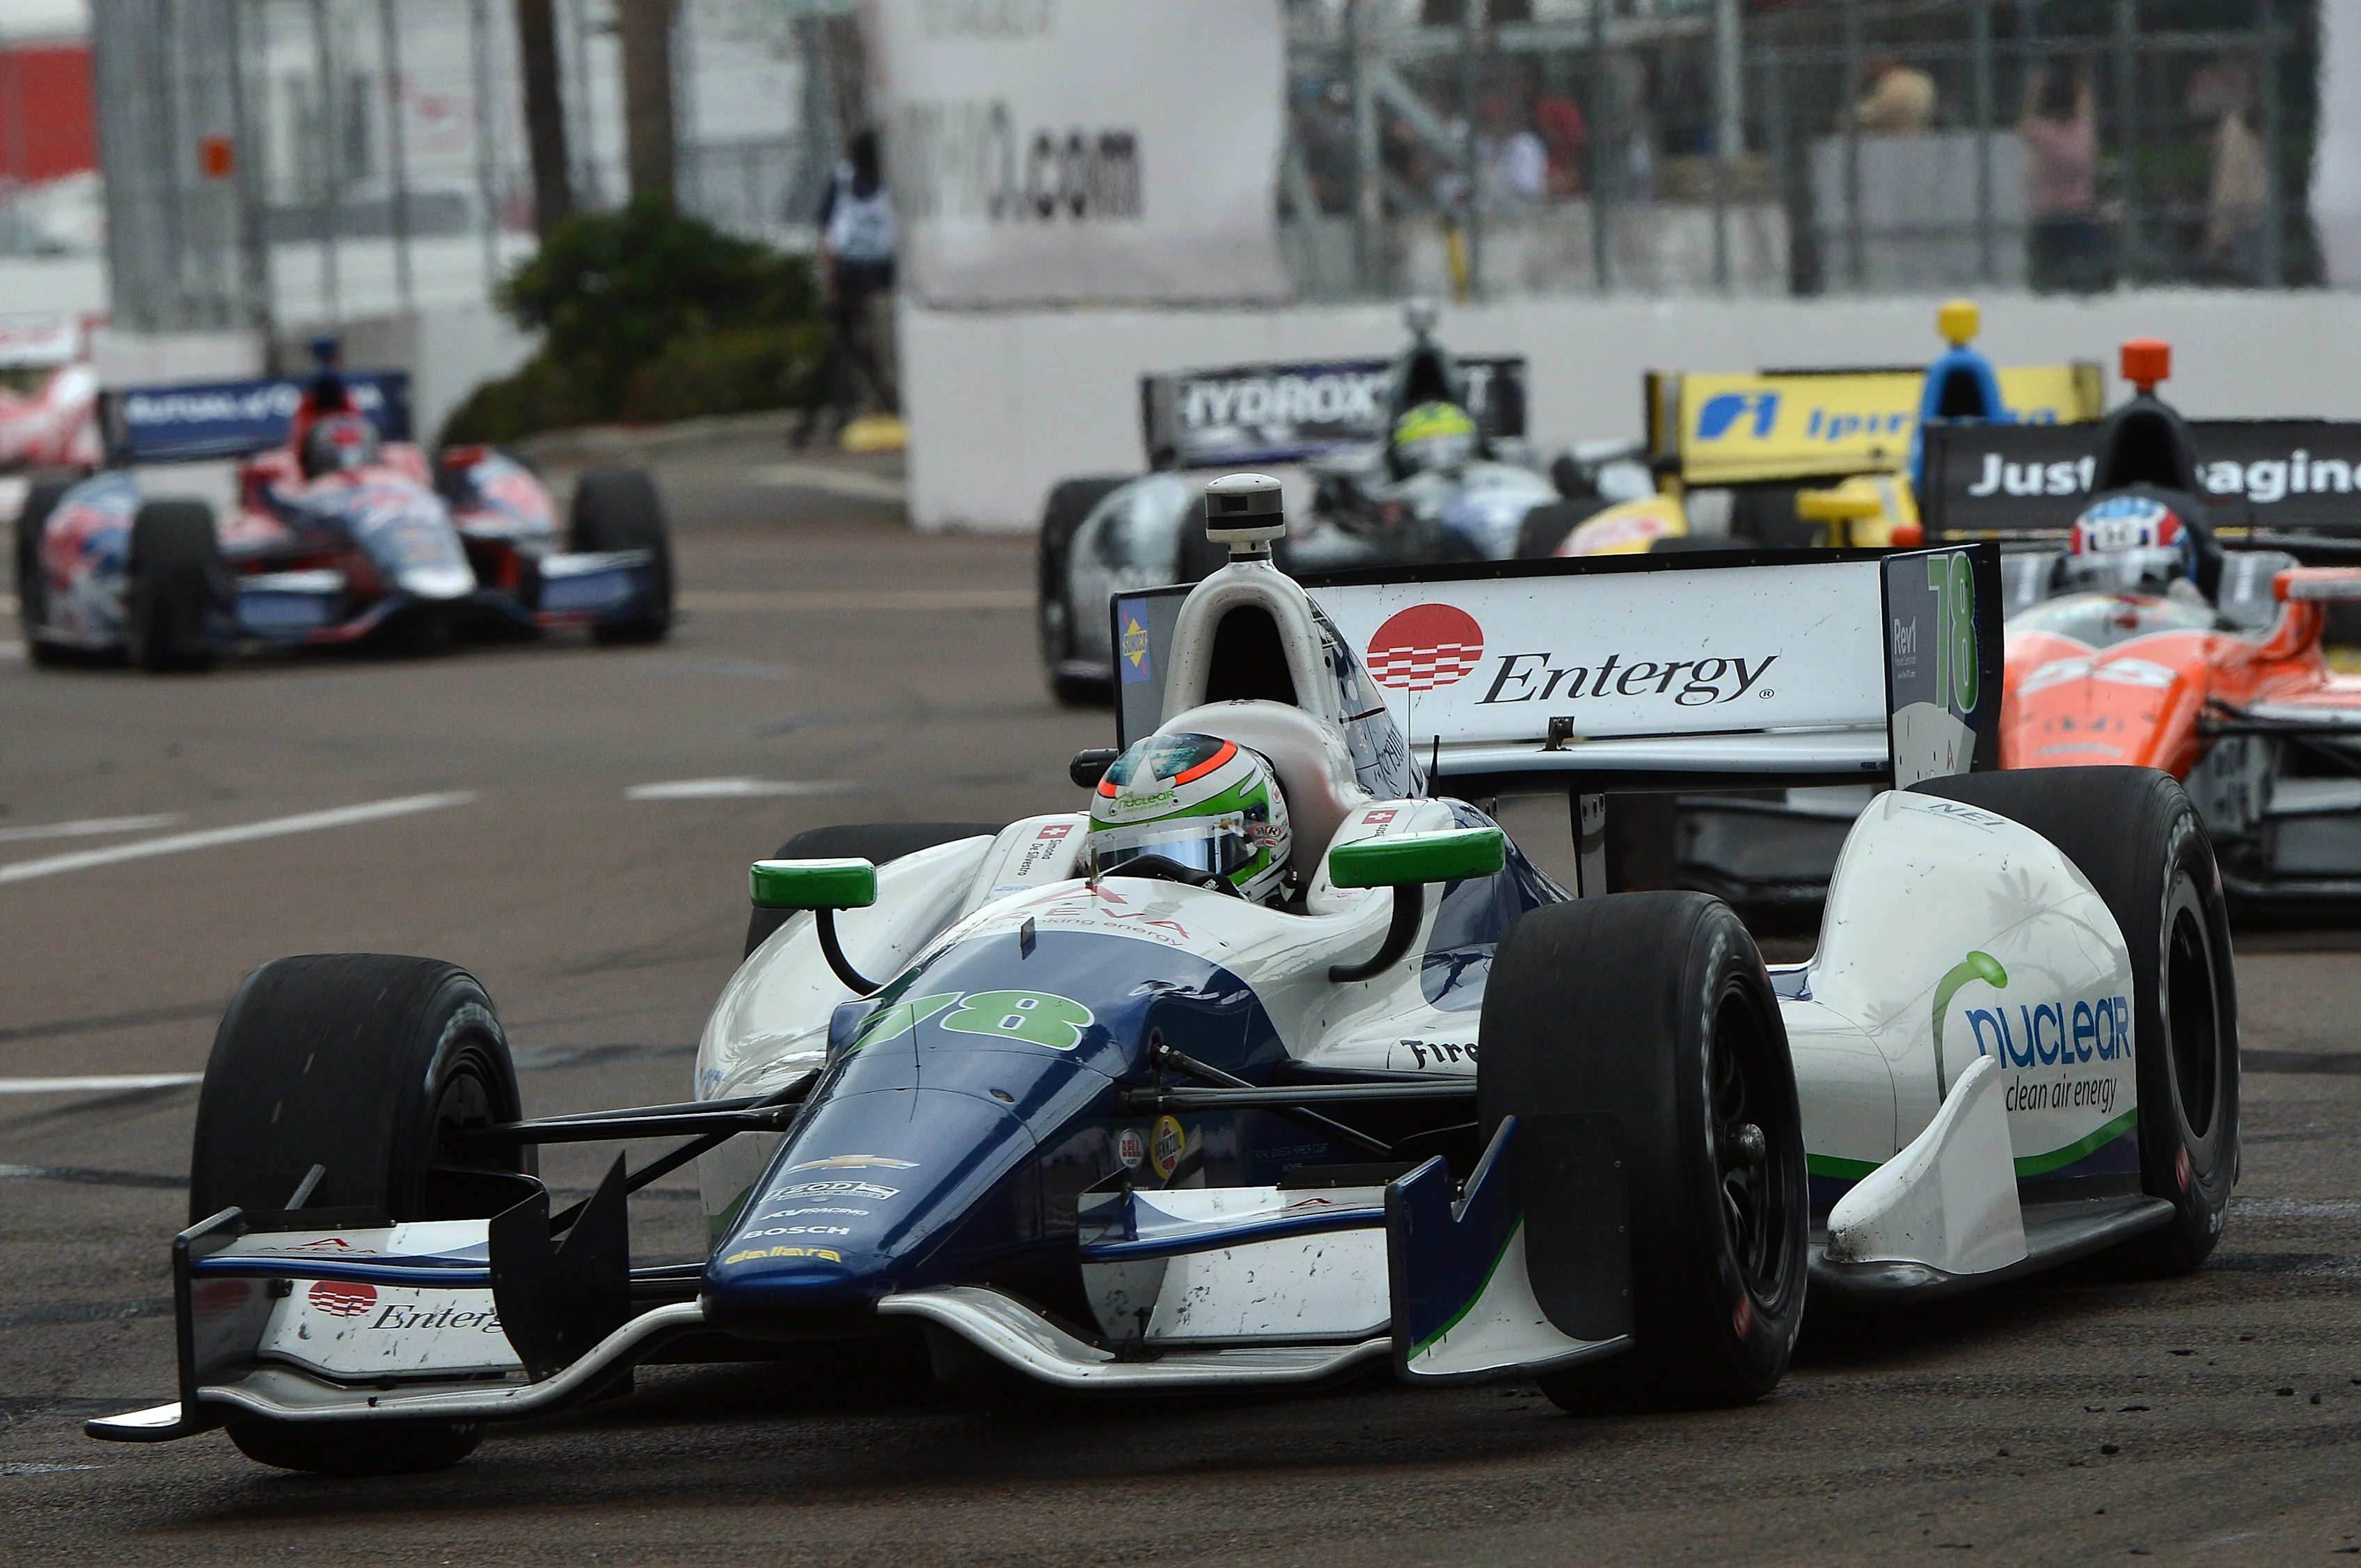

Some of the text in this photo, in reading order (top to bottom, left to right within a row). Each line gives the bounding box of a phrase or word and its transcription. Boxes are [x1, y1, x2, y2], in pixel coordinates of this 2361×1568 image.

[1893, 615, 1916, 655] Rev1
[1927, 551, 1980, 714] 78
[1474, 651, 1780, 706] Entergy
[1927, 803, 2007, 826] NEI
[1017, 842, 1044, 876] De Silvestro
[1041, 839, 1062, 860] Simona
[1103, 922, 1183, 946] energy
[836, 990, 1096, 1063] 78
[2005, 1073, 2117, 1114] clean air energy
[742, 1226, 851, 1240] BOSCH
[725, 1246, 842, 1265] dallara
